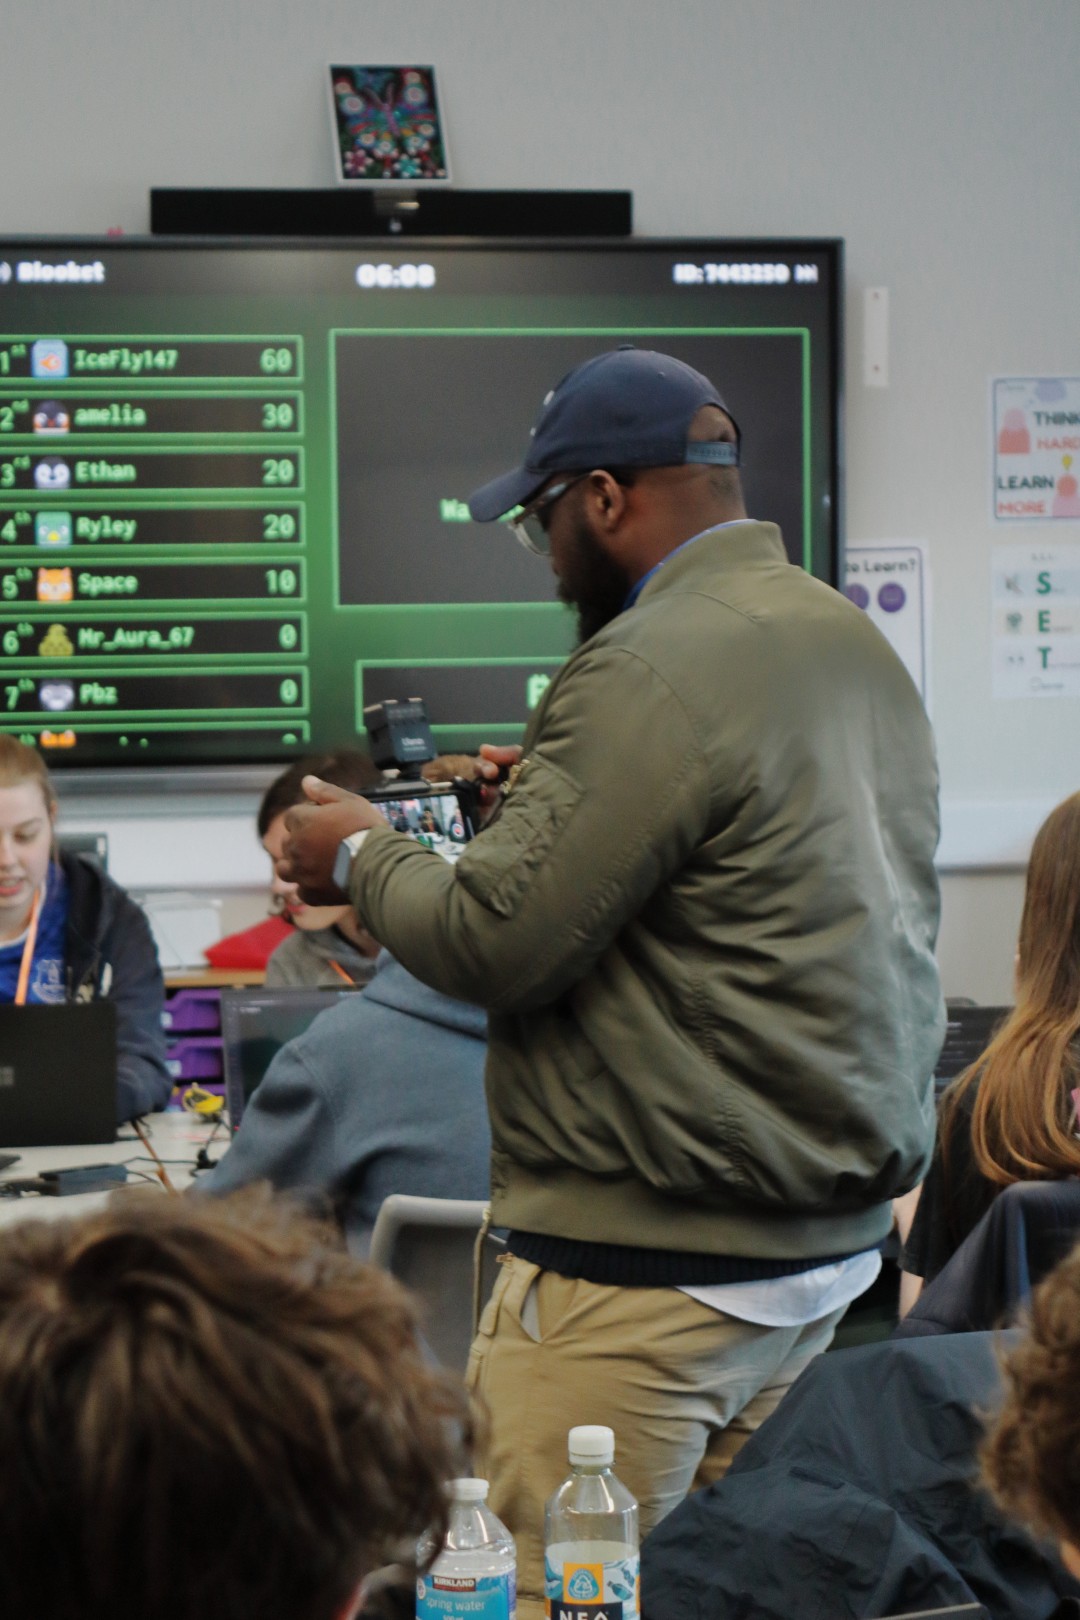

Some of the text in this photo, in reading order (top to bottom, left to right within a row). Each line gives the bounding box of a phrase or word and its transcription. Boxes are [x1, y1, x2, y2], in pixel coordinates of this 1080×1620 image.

[17, 260, 105, 283] Blooket
[74, 348, 178, 373] IceFly147
[261, 348, 292, 373] 60
[74, 403, 147, 426] amelia
[262, 403, 293, 429] 30
[75, 460, 137, 482] Ethan
[262, 459, 295, 485] 20
[997, 475, 1054, 489] LEARN
[997, 501, 1046, 514] MORE
[76, 515, 137, 541] Ryley
[263, 513, 296, 539] 20
[863, 558, 916, 573] Learn?
[78, 573, 138, 597] Space
[265, 569, 297, 595] 10
[1036, 571, 1052, 596] S
[1038, 610, 1051, 633] E
[279, 623, 298, 649] 0
[1037, 645, 1053, 670] T
[280, 679, 299, 704] 0
[434, 1576, 475, 1588] KIRKLAND
[455, 1601, 486, 1612] water
